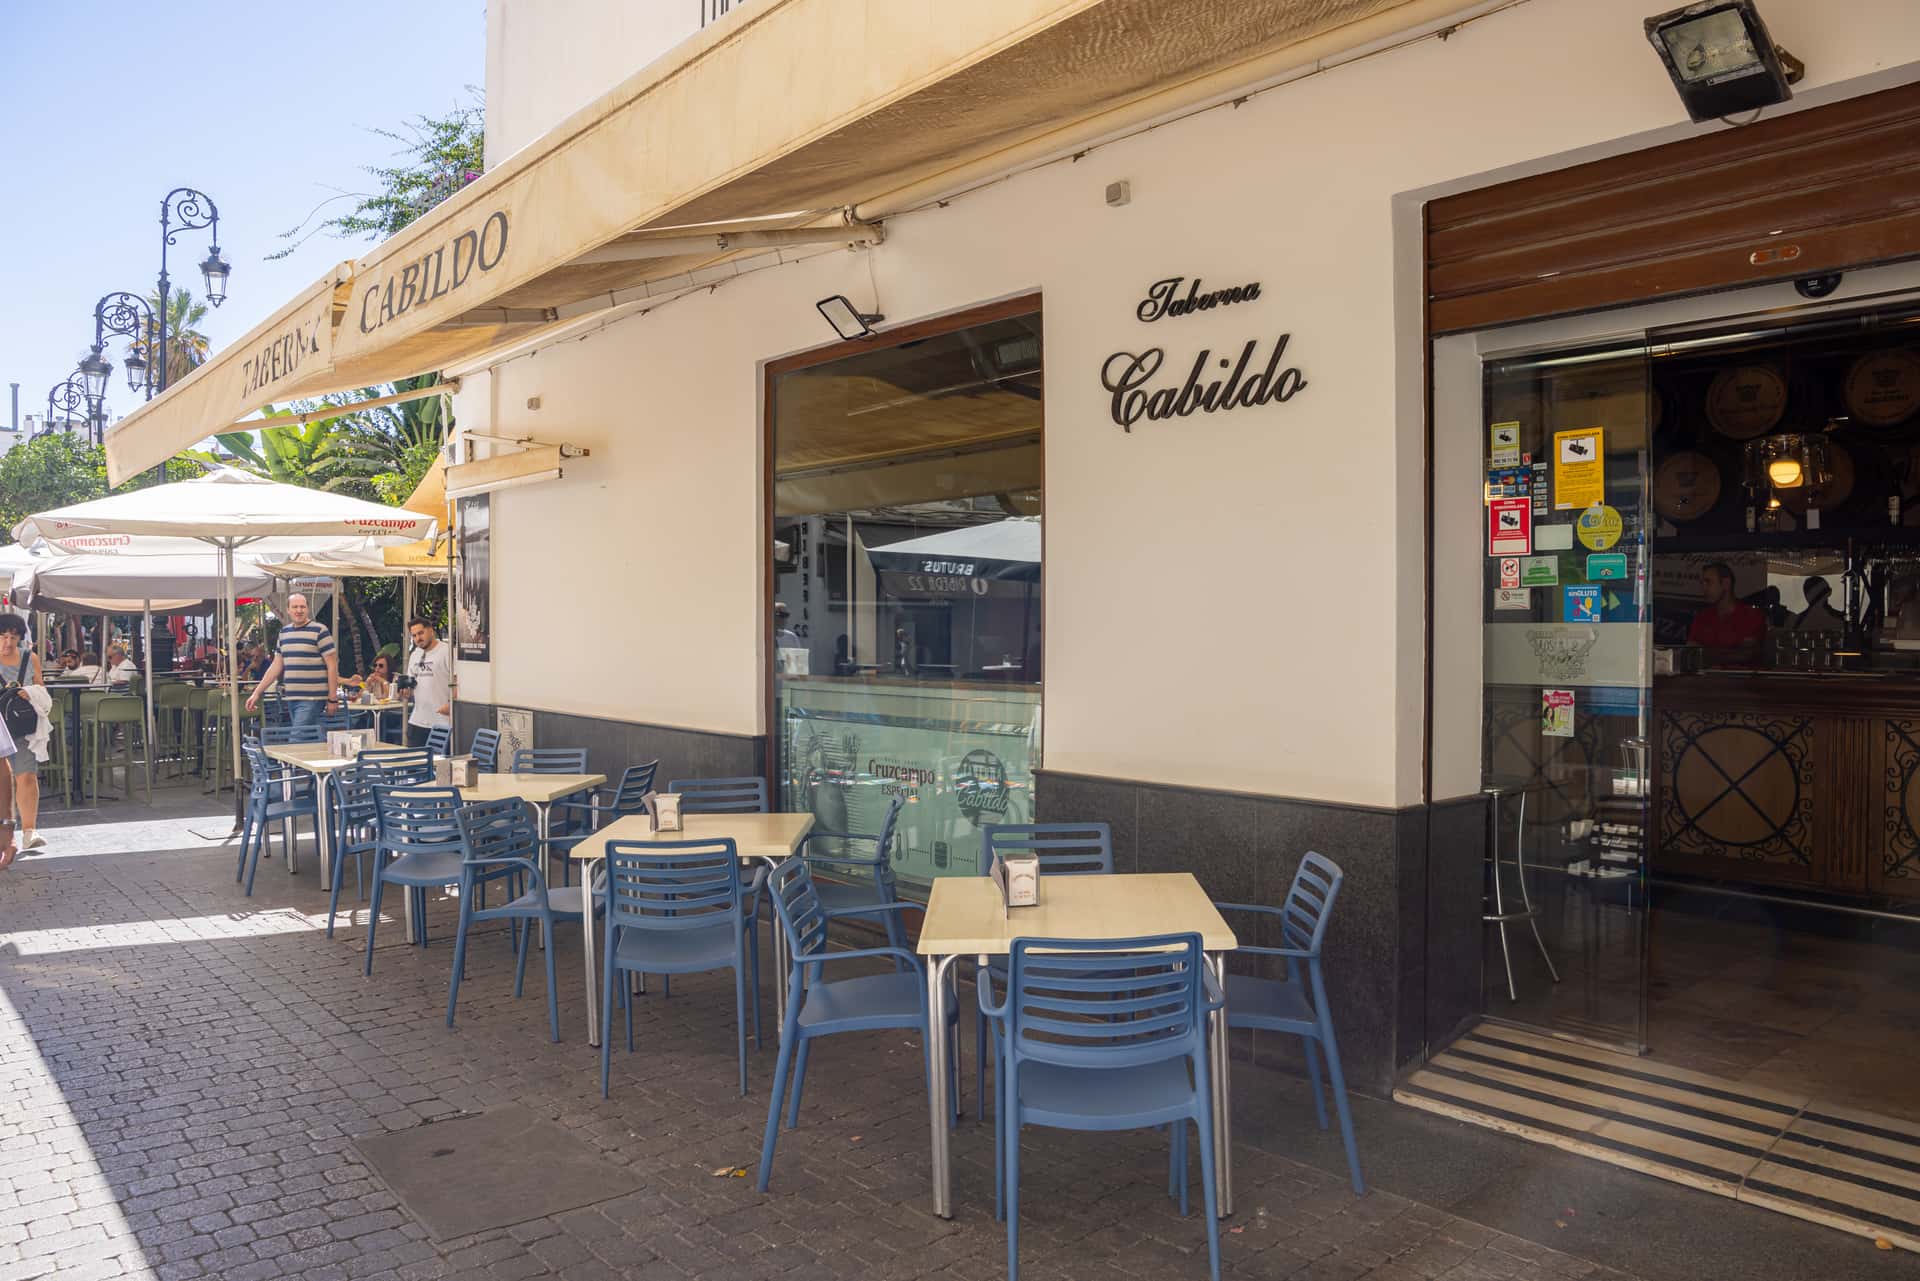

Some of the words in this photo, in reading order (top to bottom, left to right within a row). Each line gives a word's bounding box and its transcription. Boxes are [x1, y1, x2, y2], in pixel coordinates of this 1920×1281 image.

[360, 211, 508, 334] CABILDO
[1136, 277, 1261, 322] Taberna
[1101, 333, 1307, 433] Cabildo
[868, 759, 935, 787] Cruzcampo
